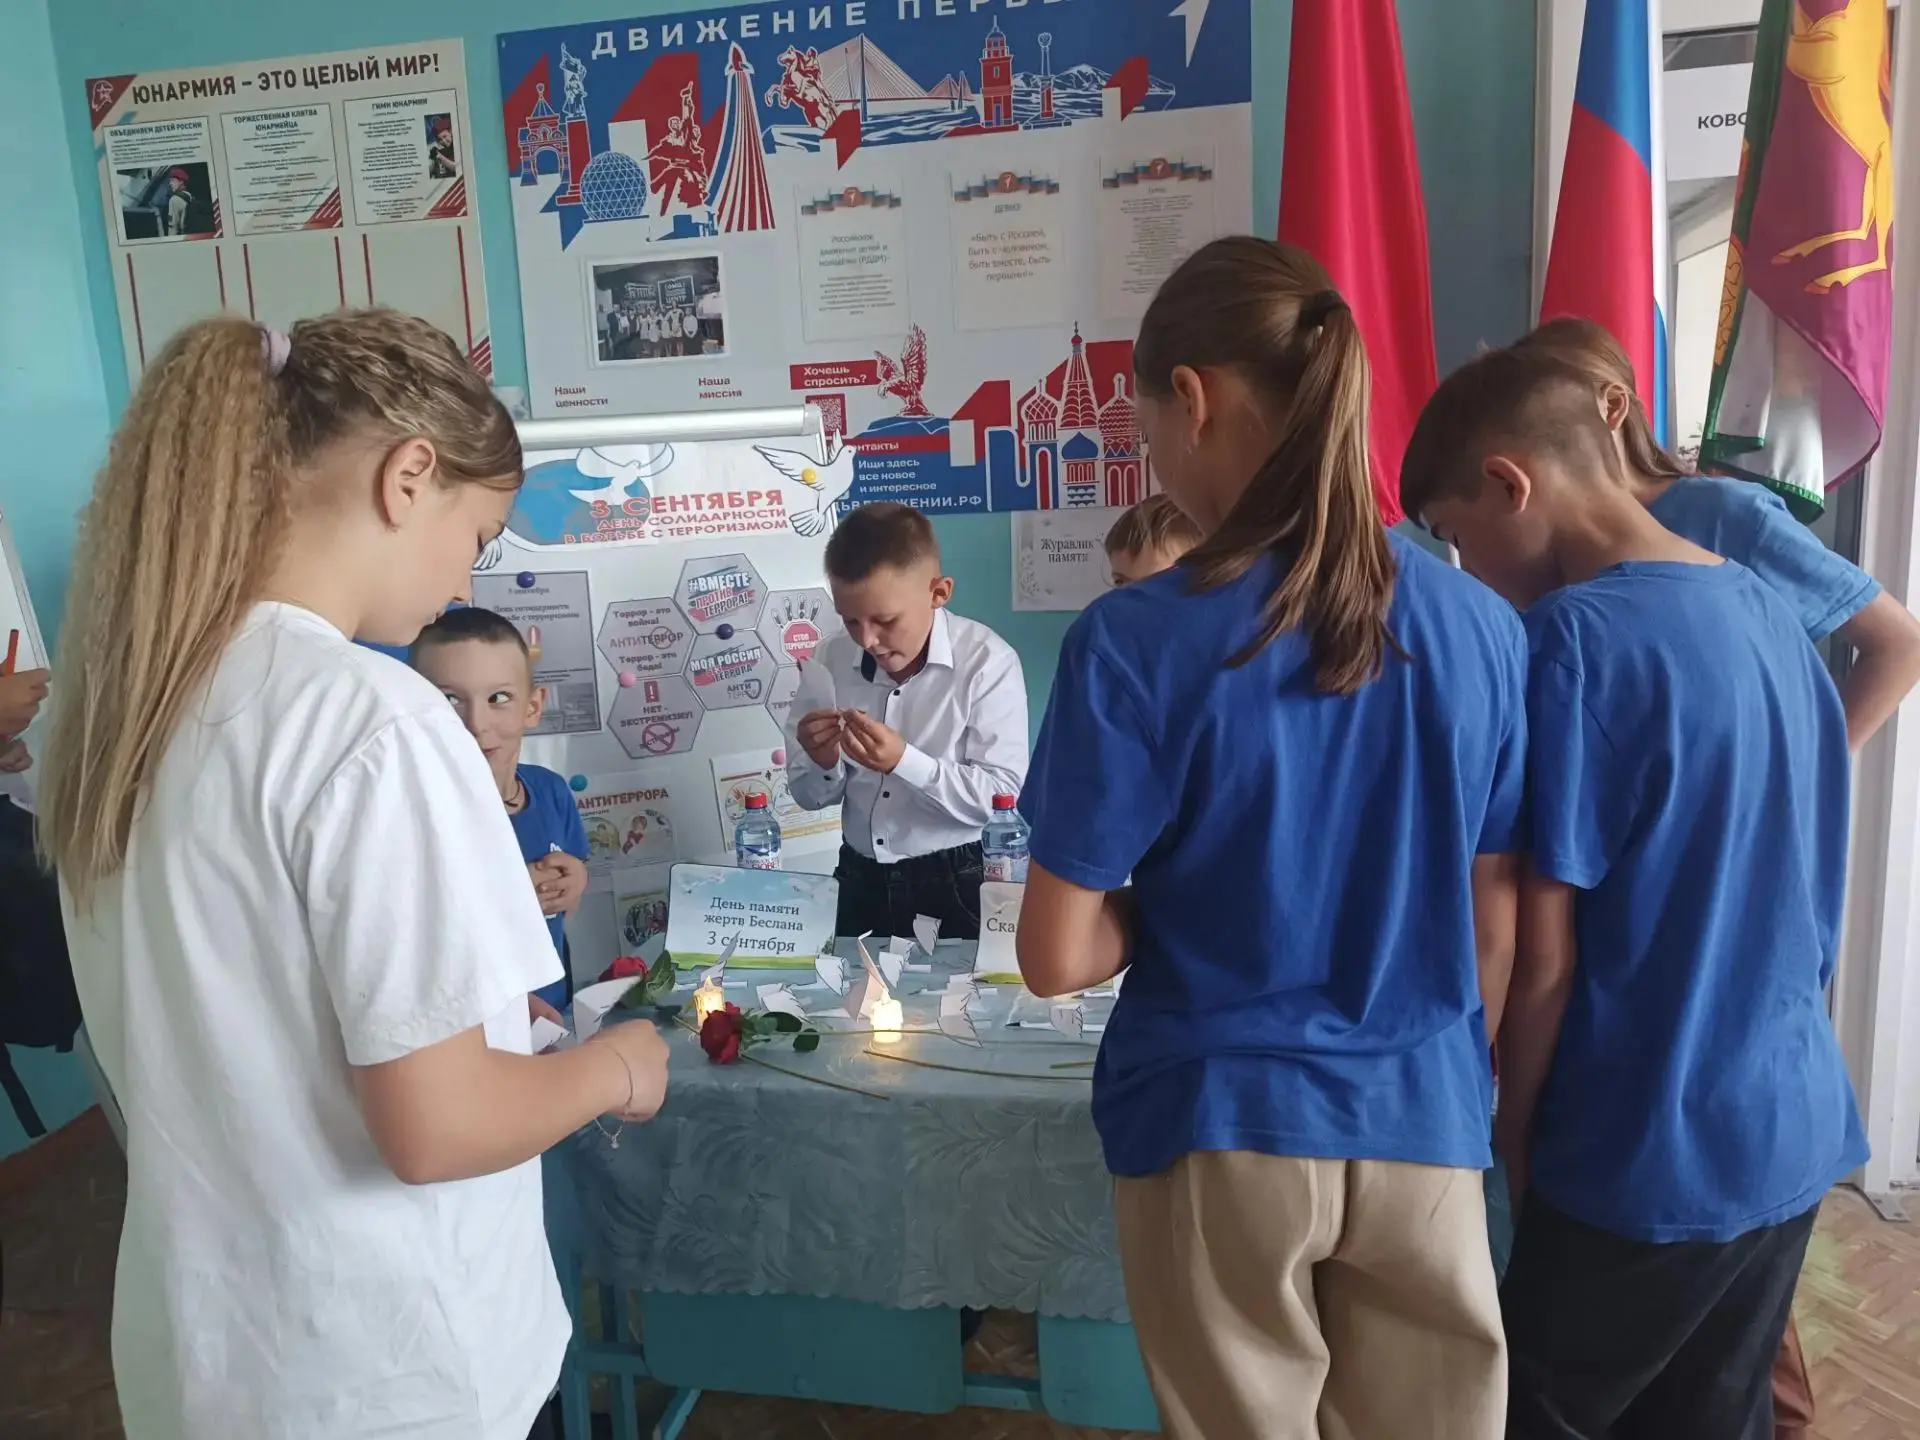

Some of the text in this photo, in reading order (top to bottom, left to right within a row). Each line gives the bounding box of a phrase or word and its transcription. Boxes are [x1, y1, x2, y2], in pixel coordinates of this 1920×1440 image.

[591, 2, 867, 60] ДВИЖЕНИЕ
[132, 76, 236, 104] ЮНАРМИЯ
[257, 69, 297, 91] ЭТО
[303, 56, 380, 89] ЦЕЛЫЙ
[386, 54, 440, 77] МИР!
[372, 102, 391, 111] ГИМН
[233, 108, 318, 124] ТОРЖЕСТВЕННАЯ КЛЯТВА
[154, 123, 175, 133] ДЕТЕЙ
[177, 121, 203, 131] РОССИИ
[255, 120, 299, 131] ЮНАРМЕЙЦА
[804, 366, 850, 376] Хочешь
[698, 376, 731, 387] Наша
[804, 374, 867, 388] спросить?
[554, 386, 587, 396] Наши
[699, 389, 742, 400] миссия
[555, 397, 609, 409] ценности
[858, 459, 920, 470] Ищи здесь
[859, 471, 916, 481] все новое
[869, 482, 937, 493] интересное
[591, 489, 784, 518] 3 СЕНТЯБРЯ
[597, 508, 787, 532] ДЕНЬ СОЛИДАРНОСТИ
[564, 519, 789, 545] В БОРЬБЕ С ТЕРРОРИЗМОМ
[688, 571, 750, 594] #ВМЕСТЕ
[695, 587, 733, 609] ПРОТИВ
[704, 593, 749, 618] ТЕРРОРА!
[613, 609, 648, 619] Террор
[655, 607, 672, 615] это
[619, 656, 654, 665] Террор
[690, 657, 716, 672] МОЯ
[717, 649, 761, 666] РОССИЯ
[577, 787, 669, 809] АНТИТЕРРОРА
[710, 896, 800, 916] День памяти
[704, 912, 804, 932] жертв Беслана
[707, 930, 796, 955] 3 снтября
